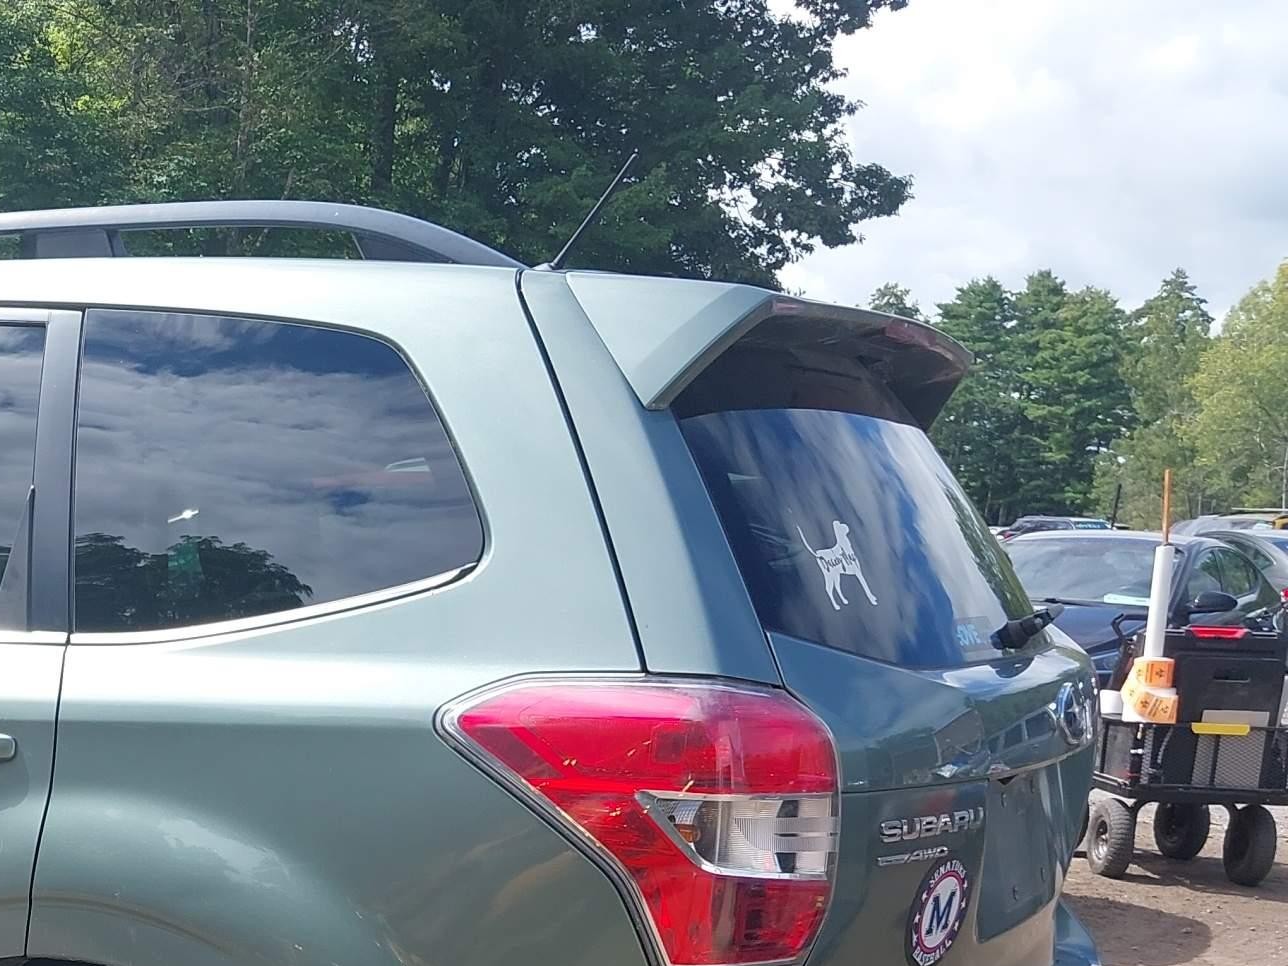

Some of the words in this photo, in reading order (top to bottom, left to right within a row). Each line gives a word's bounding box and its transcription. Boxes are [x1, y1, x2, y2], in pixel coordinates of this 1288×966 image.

[879, 806, 984, 843] SUBARU
[909, 845, 949, 861] AWD
[926, 890, 956, 937] M
[911, 937, 953, 966] BASEBALL
